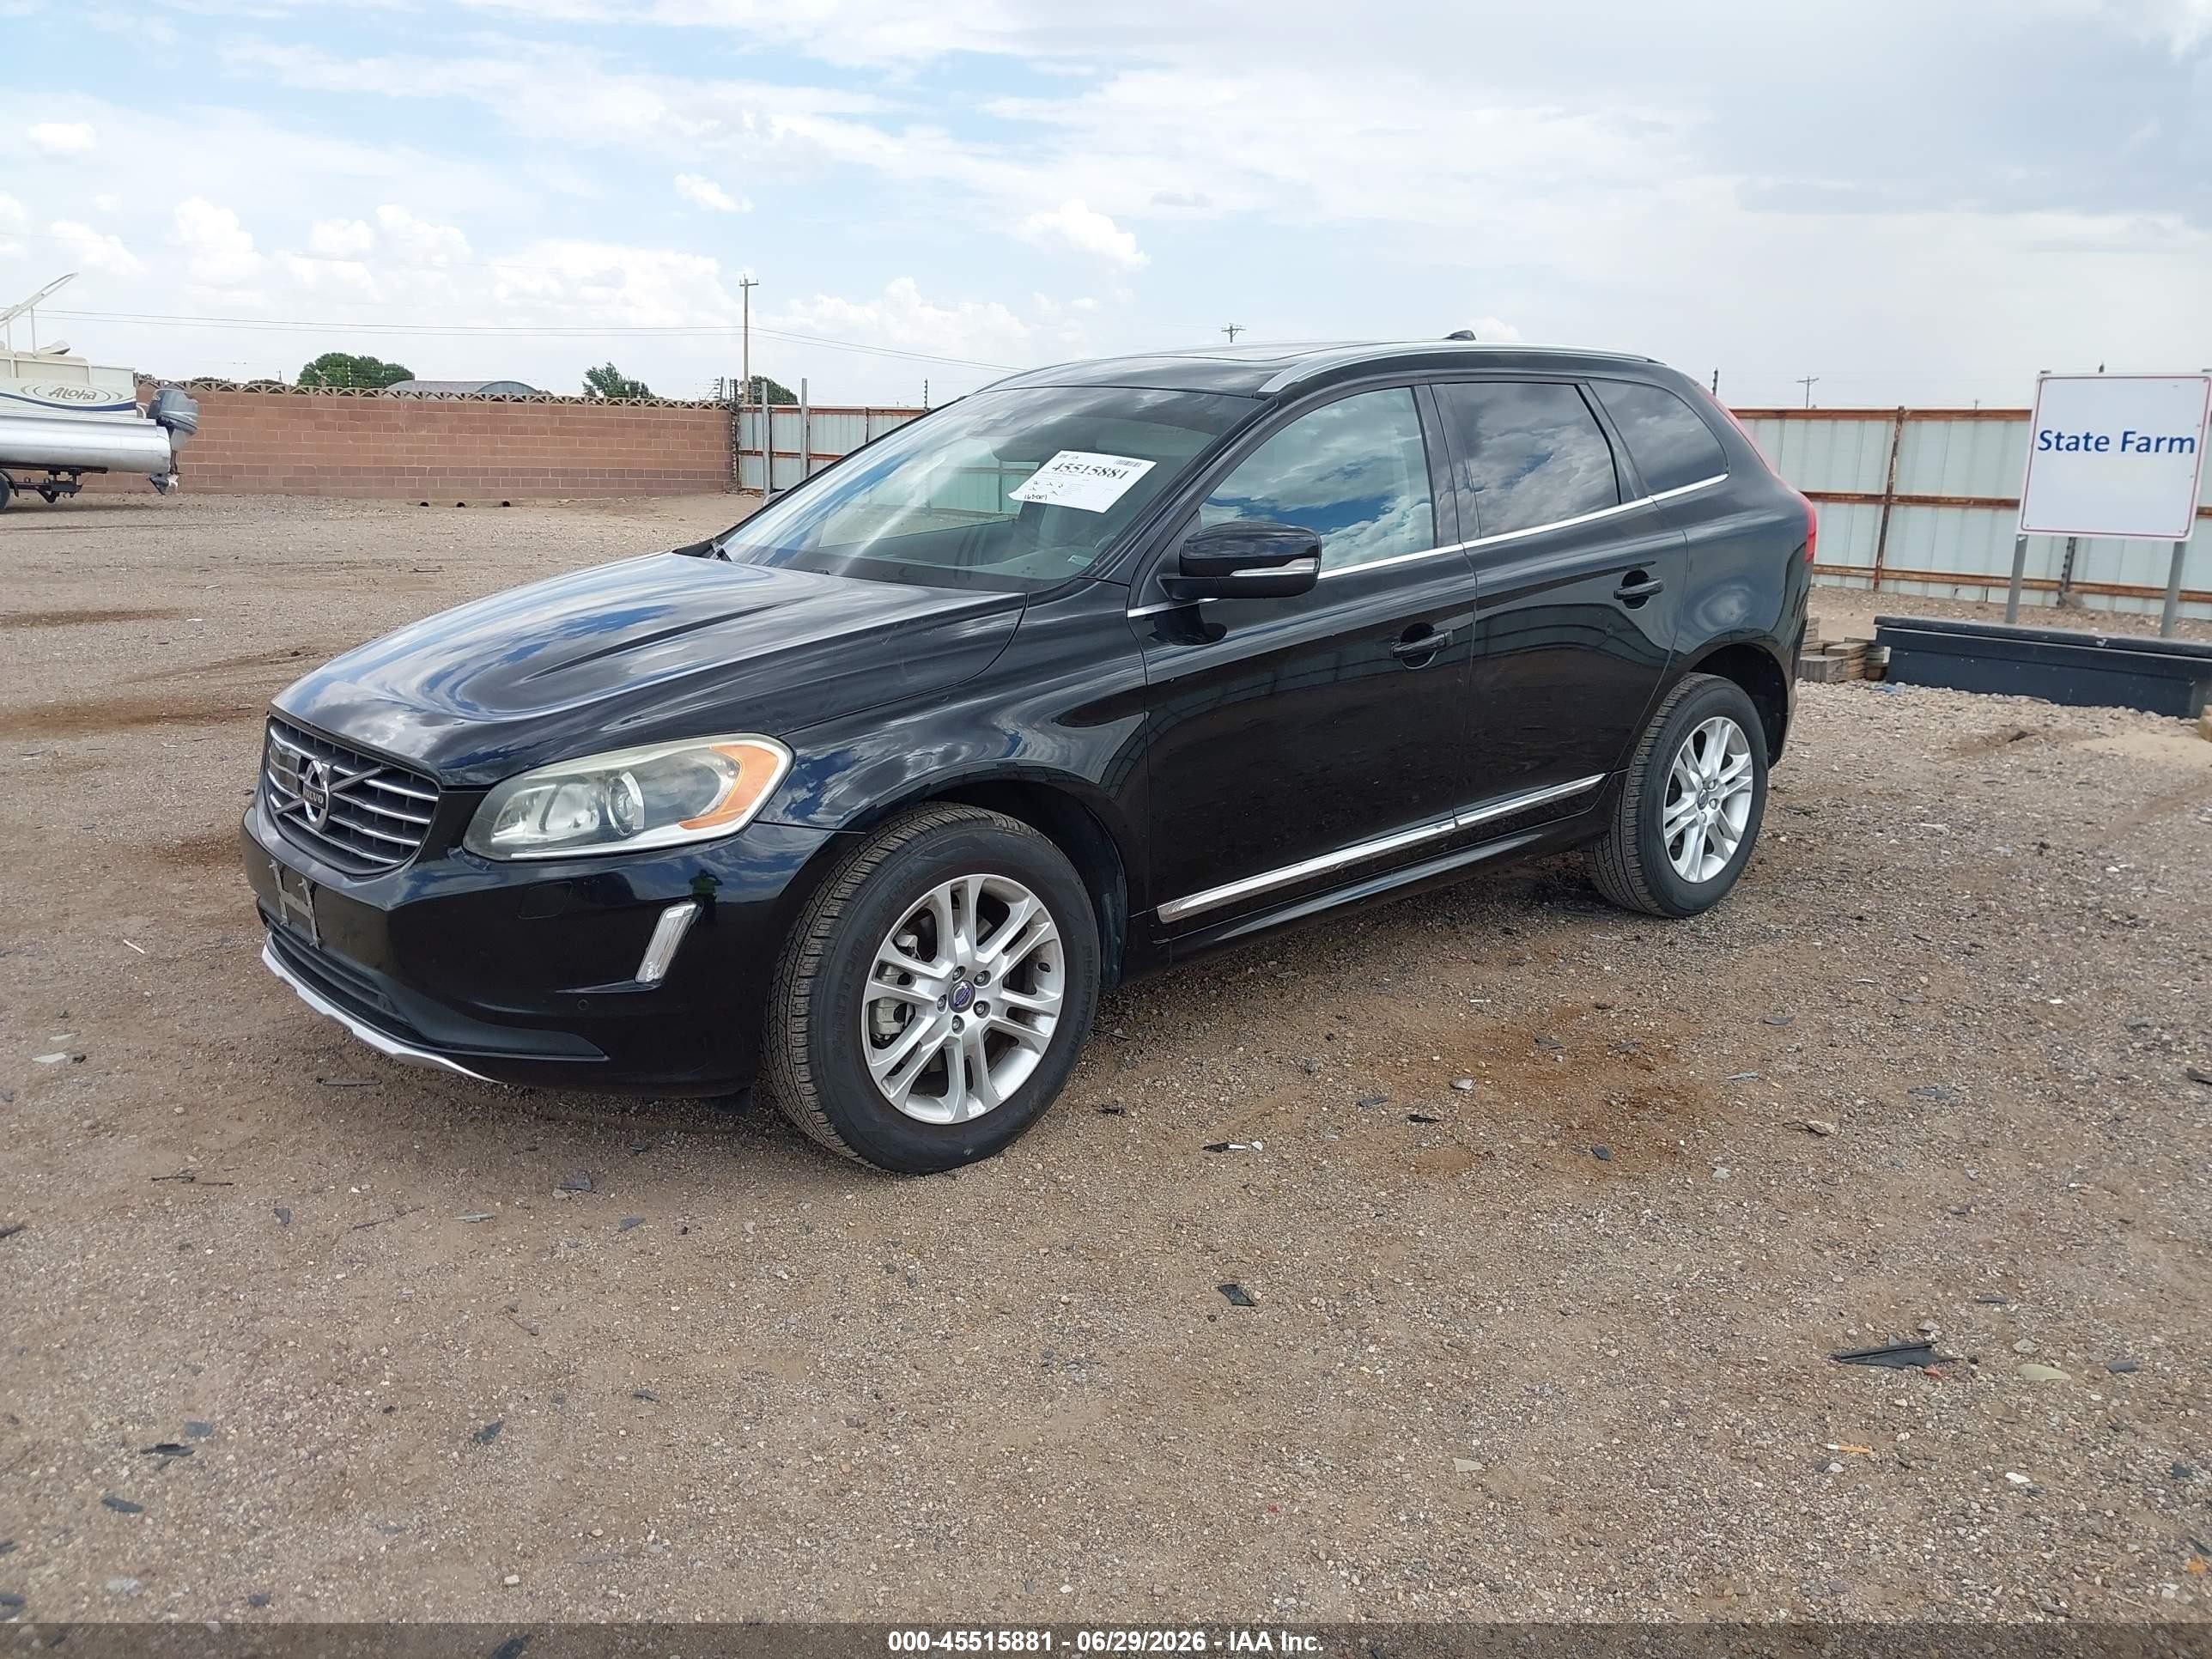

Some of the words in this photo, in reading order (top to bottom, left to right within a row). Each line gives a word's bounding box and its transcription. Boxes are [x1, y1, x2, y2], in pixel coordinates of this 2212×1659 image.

[2038, 429, 2111, 453] State
[2120, 430, 2195, 453] Farm
[1052, 462, 1129, 480] 45515881
